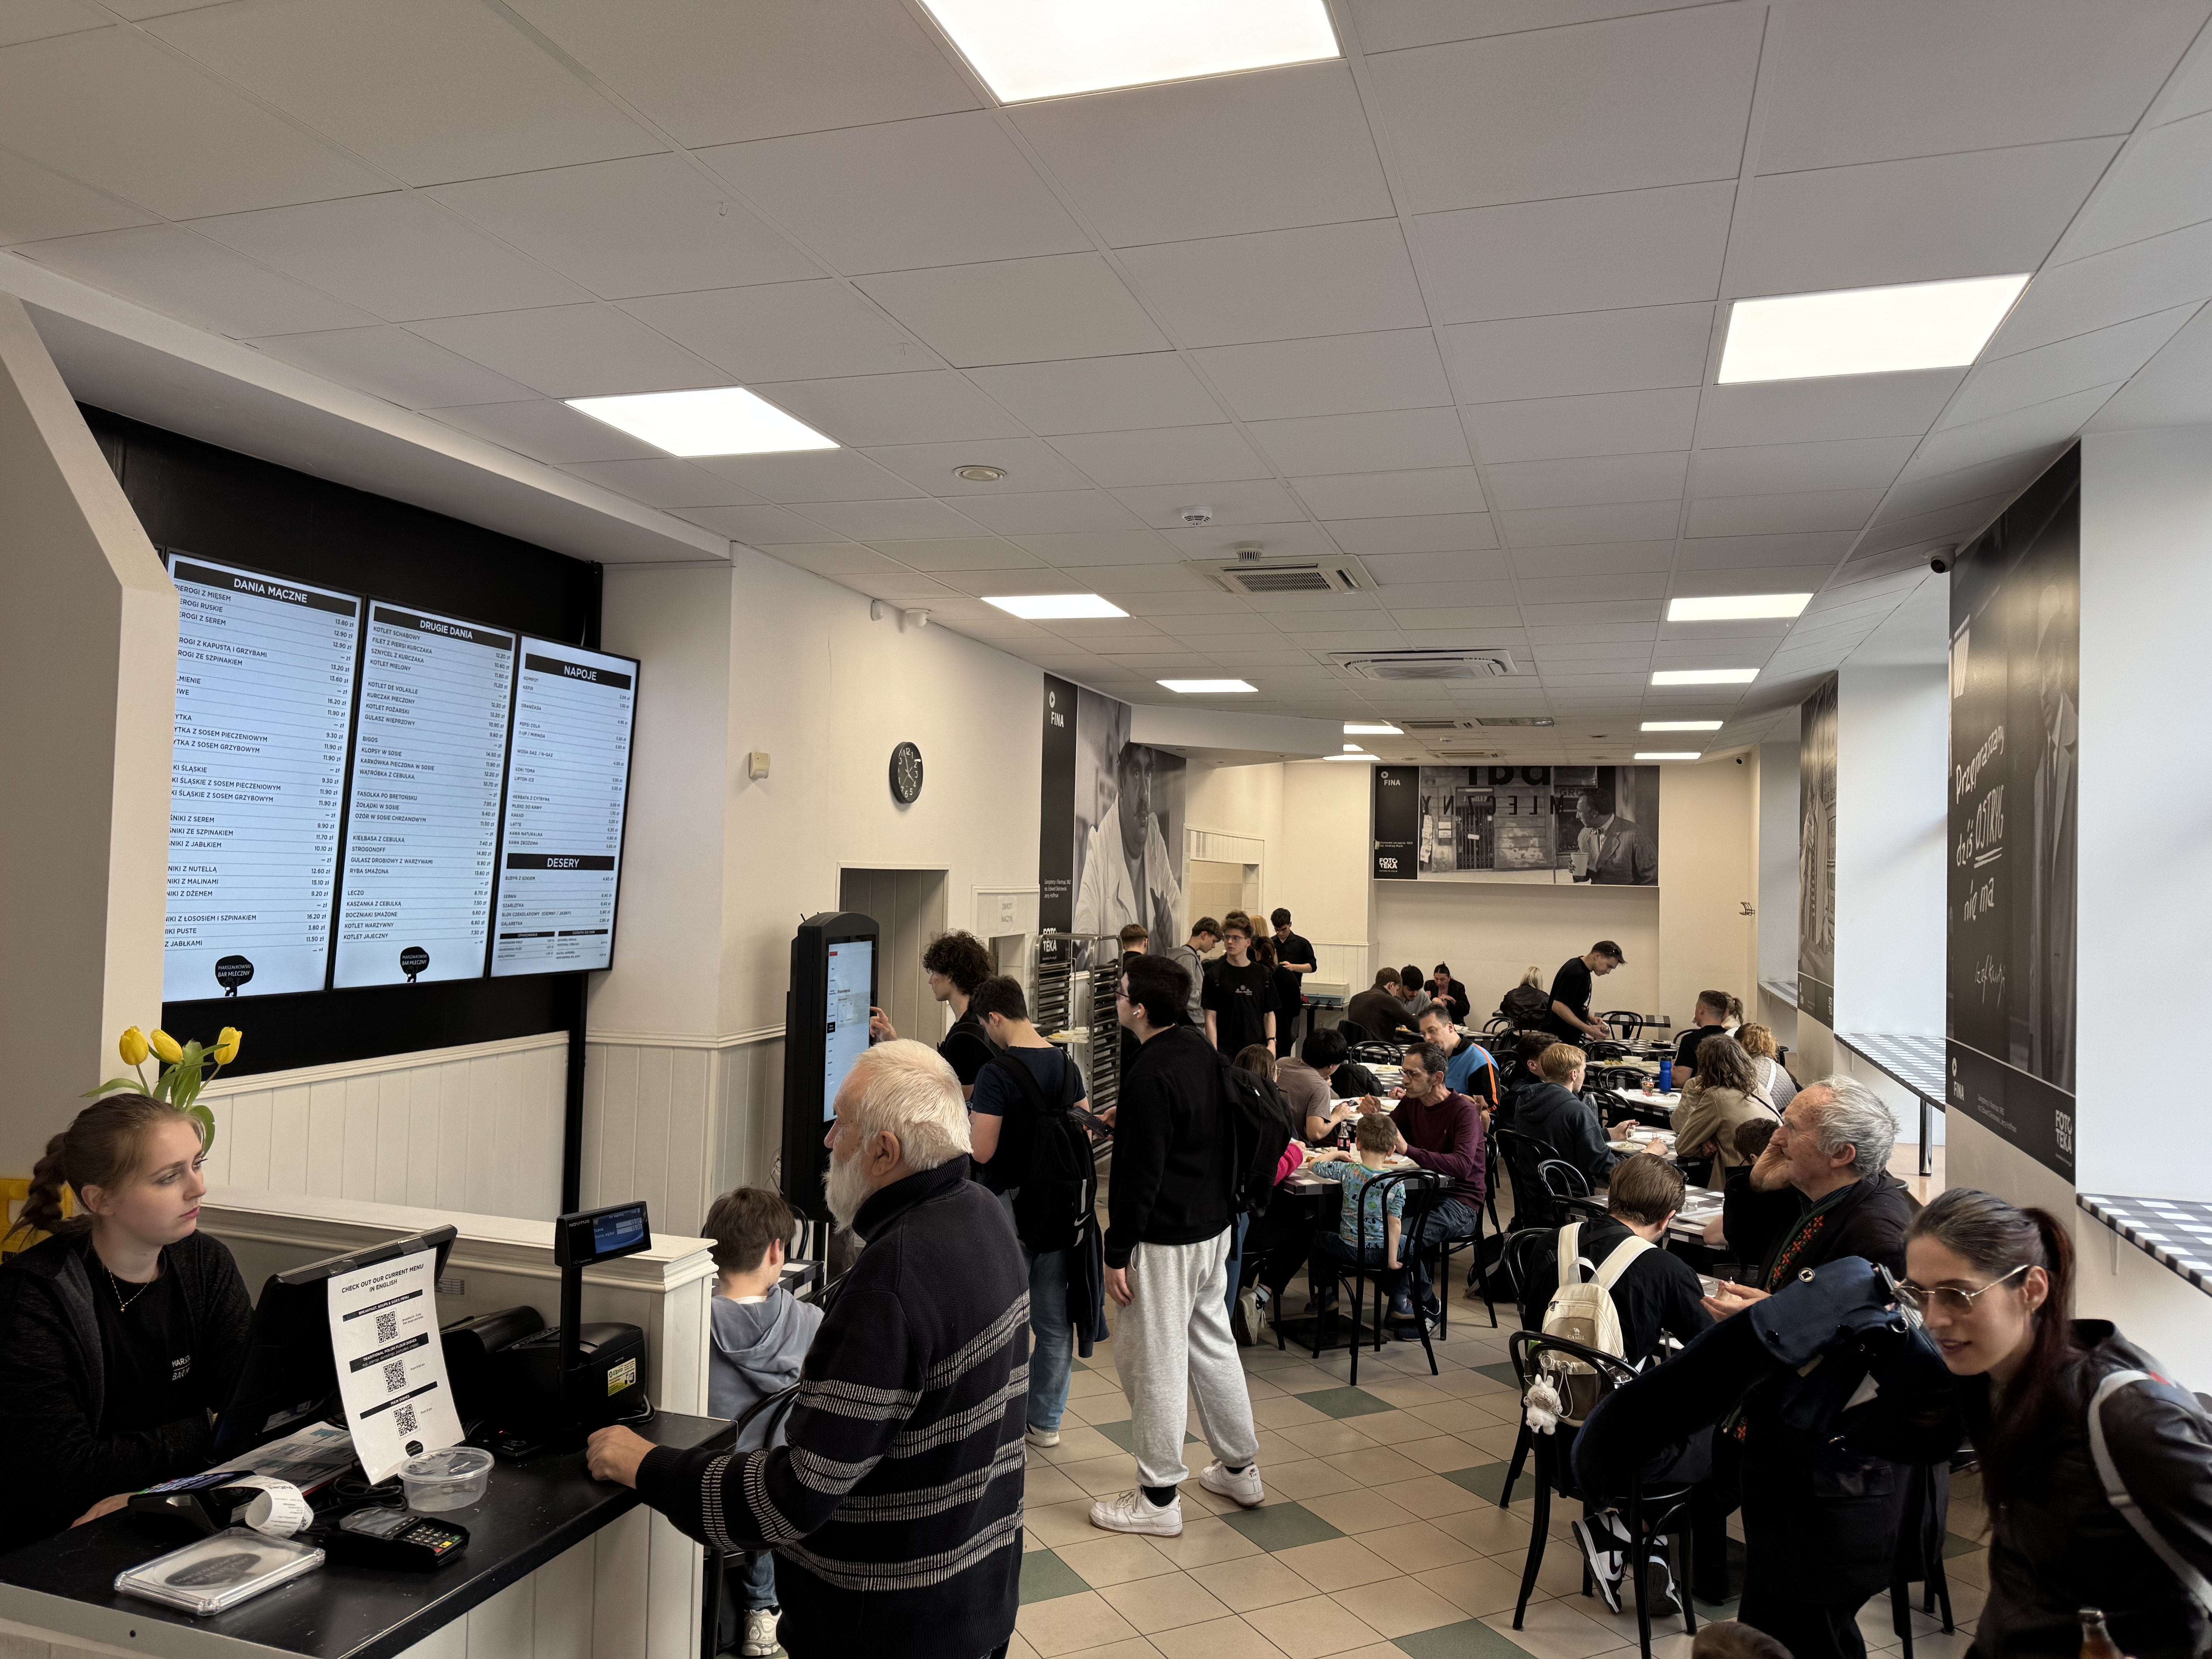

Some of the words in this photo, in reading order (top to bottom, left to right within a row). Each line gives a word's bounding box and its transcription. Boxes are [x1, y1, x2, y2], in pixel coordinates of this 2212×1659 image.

[207, 591, 231, 602] MIĘSEM
[234, 578, 265, 594] DANIA
[268, 587, 308, 603] MĄCZNE
[180, 598, 199, 608] EROGI
[200, 602, 223, 613] RUSKIE
[205, 616, 226, 626] SEREM
[373, 626, 392, 635] KOTLET
[393, 630, 421, 641] SCHABOWY
[420, 620, 448, 634] DRUGIE
[450, 627, 473, 639] DANIA
[178, 637, 195, 645] ROGI
[203, 641, 231, 653] KAPUSTĄ
[235, 647, 267, 658] GRZYBAMI
[177, 649, 194, 658] ROGI
[205, 654, 242, 666] SZPINAKIEM
[564, 665, 597, 681] NAPOJE
[1051, 711, 1064, 728] FINA
[198, 729, 220, 737] SOSEM
[221, 731, 268, 742] PIECZENIOWYM
[197, 741, 218, 749] SOSEM
[220, 743, 260, 753] GRZYBOWYM
[180, 764, 207, 773] ŚLĄSKIE
[360, 757, 389, 766] KARKÓWKA
[390, 761, 414, 769] PIECZONA
[179, 776, 206, 785] ŚLĄSKIE
[235, 781, 281, 791] PIECZENIOWYM
[178, 788, 205, 798] ŚLĄSKIE
[234, 793, 273, 802] GRZYBOWYM
[1975, 784, 2004, 850] OSTRYG
[547, 858, 580, 868] DESERY
[1964, 878, 1978, 922] nie
[1980, 877, 1995, 915] ma
[1042, 939, 1057, 952] TEKA
[1954, 1081, 1965, 1101] FINA
[2055, 1109, 2073, 1136] FOTO
[2055, 1127, 2073, 1154] TEKA
[568, 1219, 590, 1227] NOVITUS
[342, 1283, 359, 1293] CHECK
[385, 1268, 408, 1279] CURRENT
[409, 1263, 424, 1273] MENU
[376, 1279, 398, 1290] ENGLISH
